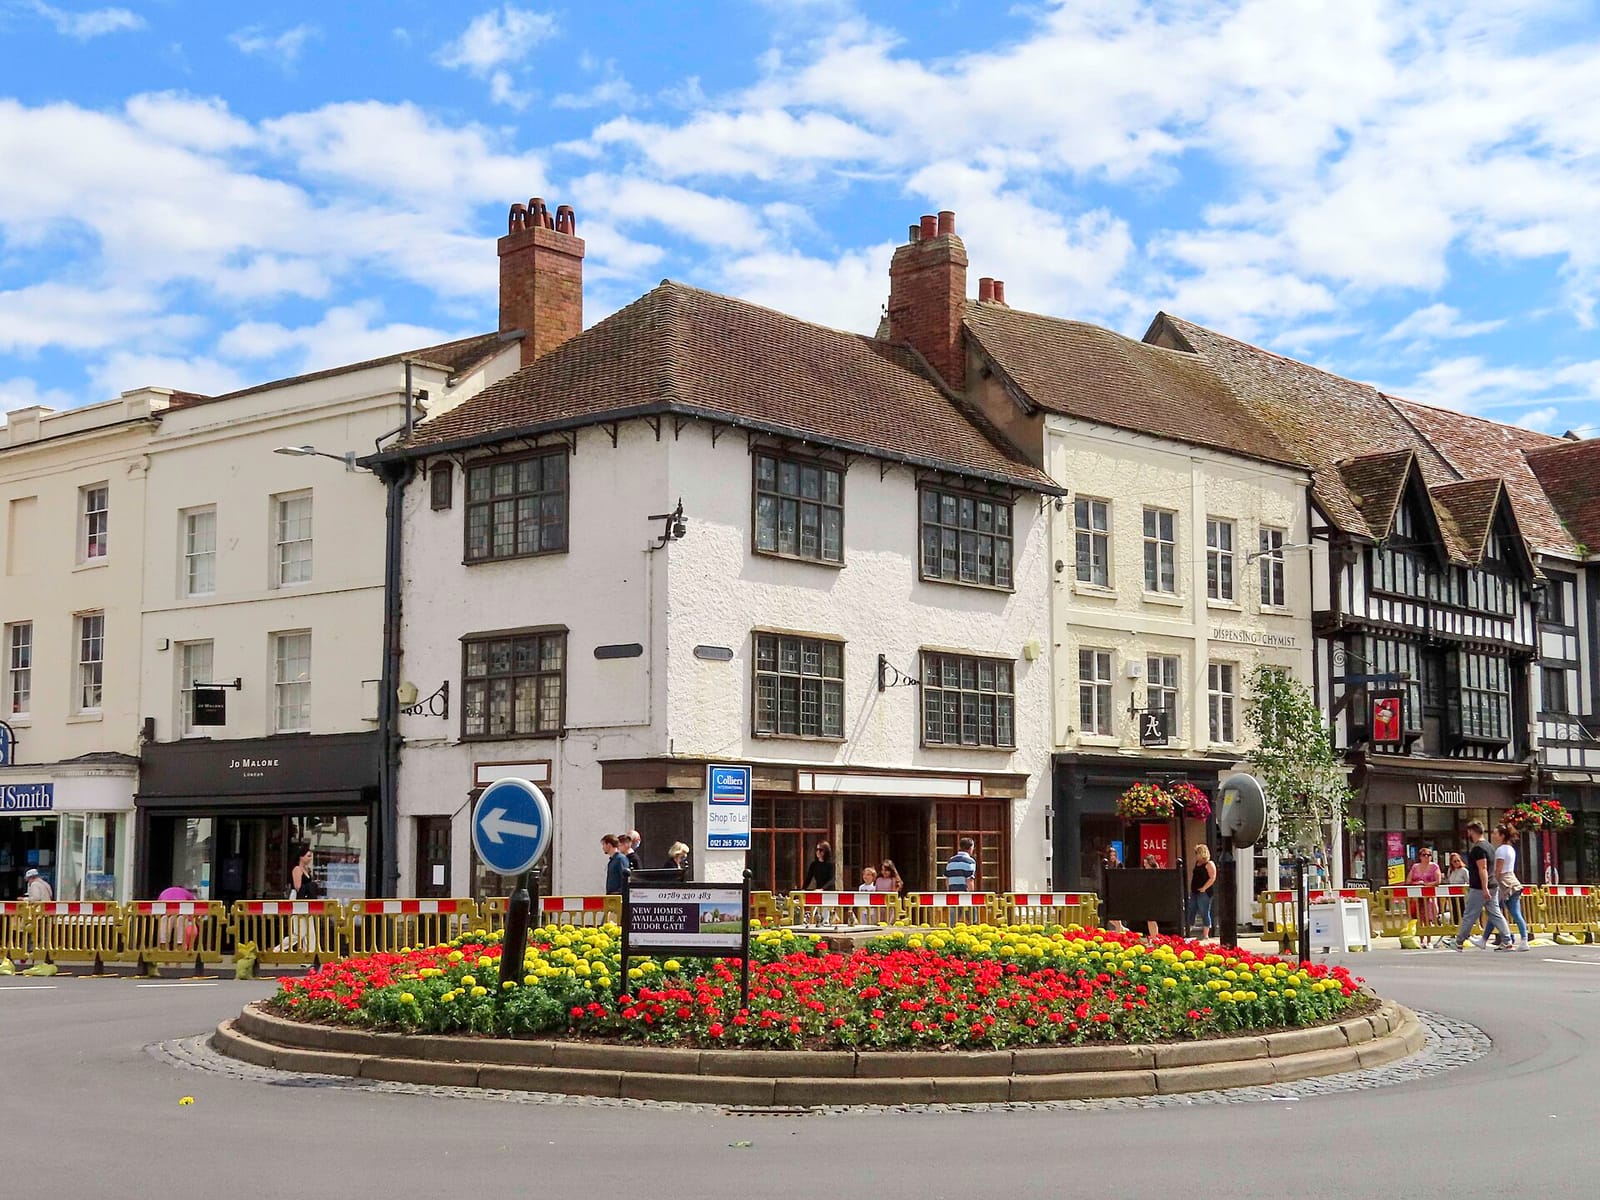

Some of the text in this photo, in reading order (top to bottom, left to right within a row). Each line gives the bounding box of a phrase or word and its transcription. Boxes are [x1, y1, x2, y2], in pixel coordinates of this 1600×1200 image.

[1213, 628, 1296, 647] DISPENSING CHYMIST
[242, 758, 279, 768] MALONE
[716, 774, 744, 786] Colliers
[1417, 782, 1467, 805] WHSmith
[709, 811, 748, 825] Shop To Let
[709, 839, 721, 847] 0121
[733, 839, 747, 847] 7500
[1143, 839, 1168, 850] SALE
[632, 907, 684, 915] NEW HOMES
[631, 915, 675, 923] AVAILABLE
[631, 923, 661, 931] TUDOR
